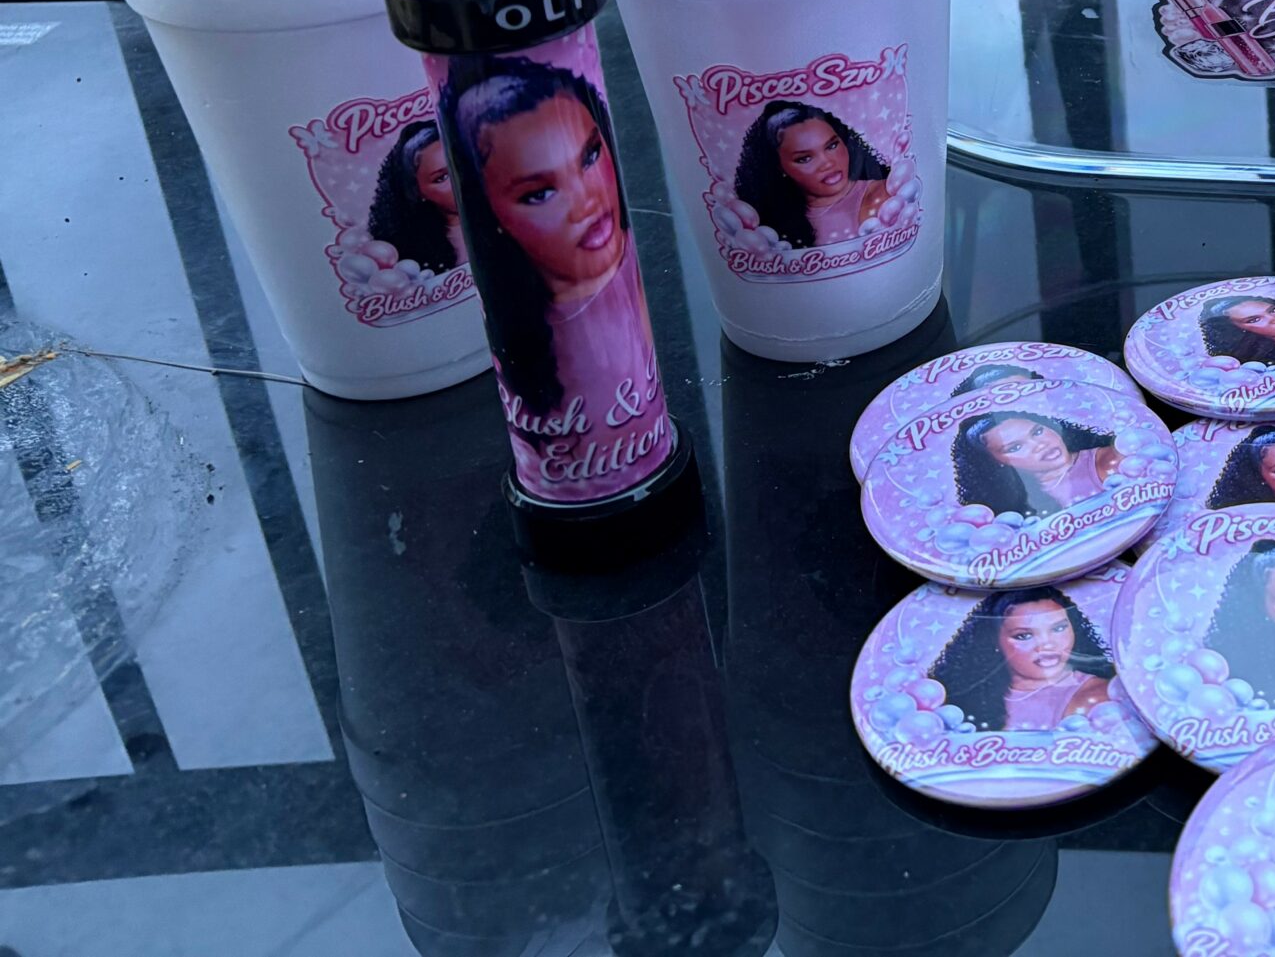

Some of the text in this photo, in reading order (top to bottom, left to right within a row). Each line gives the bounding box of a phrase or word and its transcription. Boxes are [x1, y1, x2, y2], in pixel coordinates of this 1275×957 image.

[707, 58, 881, 115] Pisces Szn
[729, 225, 918, 275] Blush & Booze Edition
[360, 285, 443, 323] Blush &
[1154, 284, 1230, 321] Pisces
[923, 343, 1084, 384] Pisces Szn
[605, 377, 646, 428] &
[898, 379, 1061, 451] Pisces Szn
[540, 414, 666, 482] Edition
[969, 533, 1038, 585] Blush
[1039, 529, 1053, 546] &
[1050, 508, 1115, 542] Booze
[876, 736, 1136, 775] Blush & Booze Edition
[1171, 717, 1250, 756] Blush
[1254, 723, 1272, 744] &
